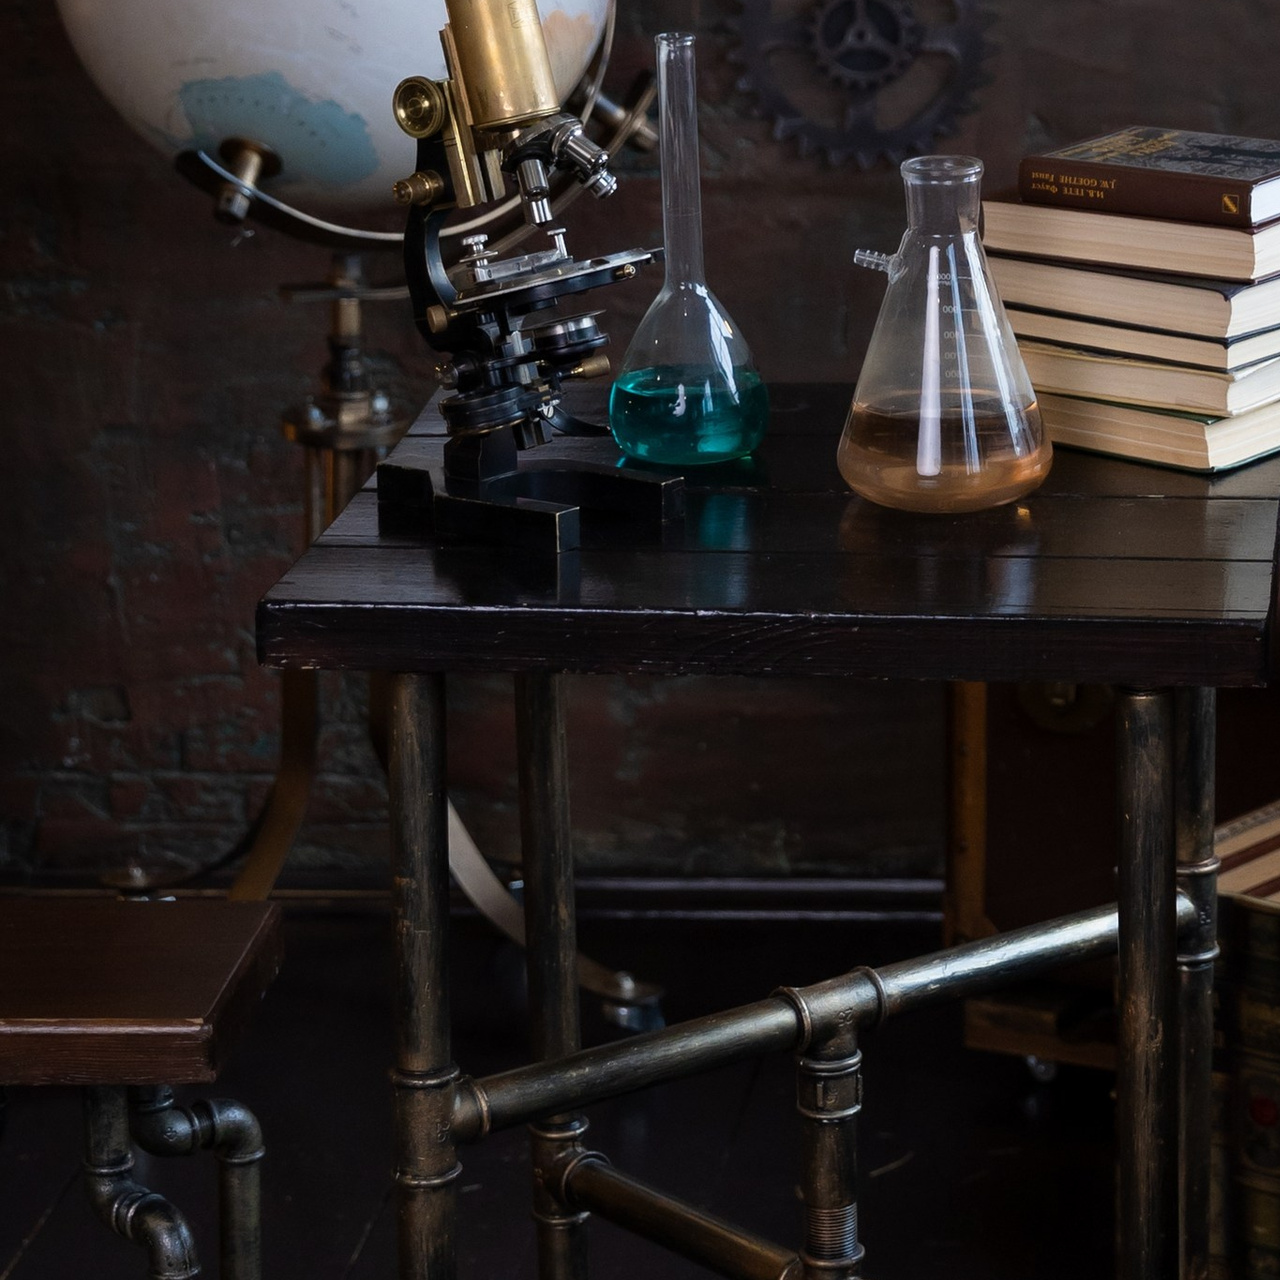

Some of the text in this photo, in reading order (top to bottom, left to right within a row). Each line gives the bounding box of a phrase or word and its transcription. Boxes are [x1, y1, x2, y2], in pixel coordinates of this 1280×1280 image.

[1031, 171, 1055, 182] Faust
[1060, 175, 1098, 187] GOETHE
[1031, 183, 1058, 194] Фауст
